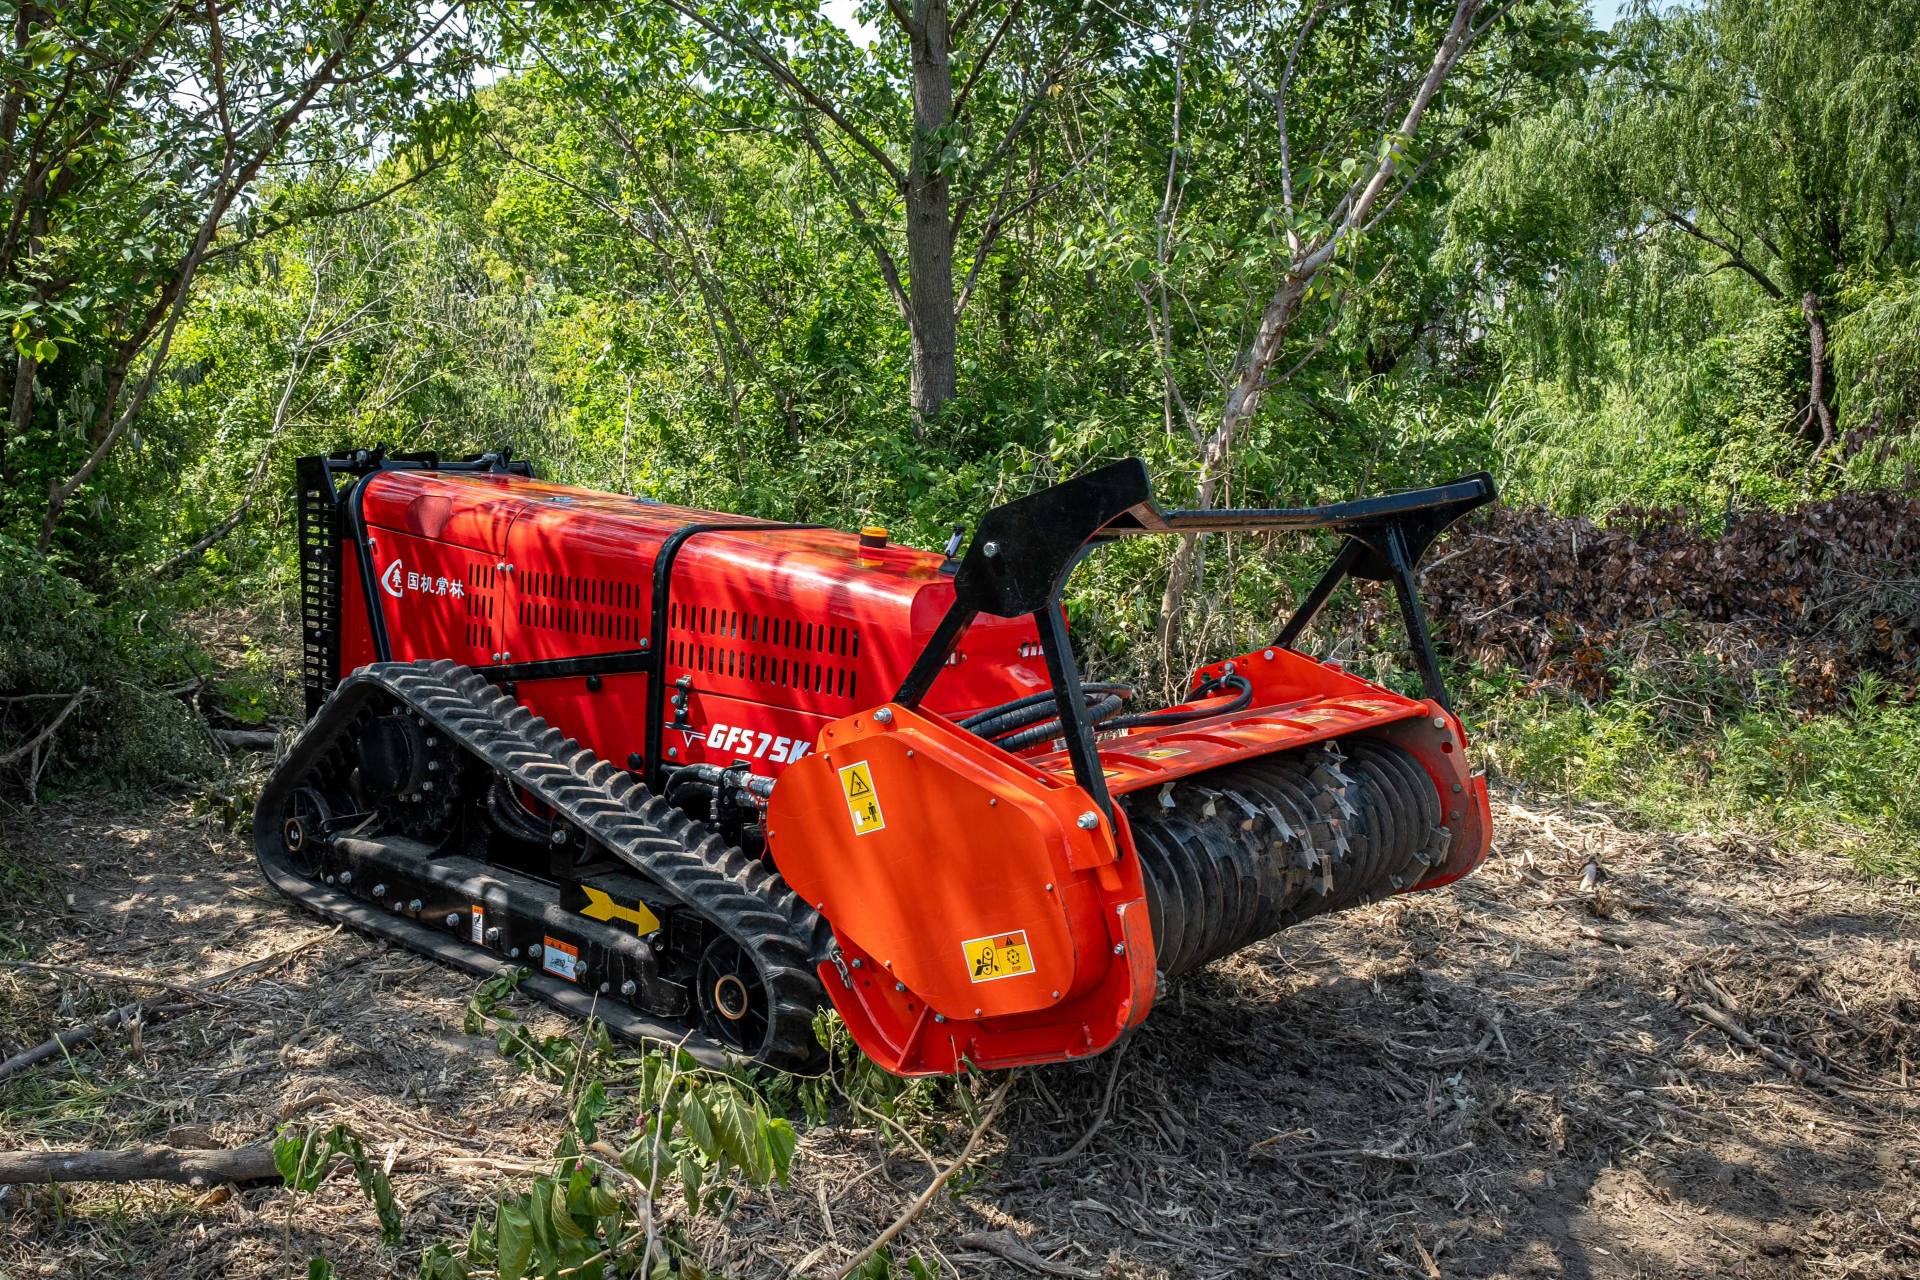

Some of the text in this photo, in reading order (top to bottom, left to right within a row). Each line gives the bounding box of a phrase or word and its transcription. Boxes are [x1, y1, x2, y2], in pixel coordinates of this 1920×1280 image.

[407, 571, 464, 599] 国机常林
[706, 723, 815, 765] GFS75K
